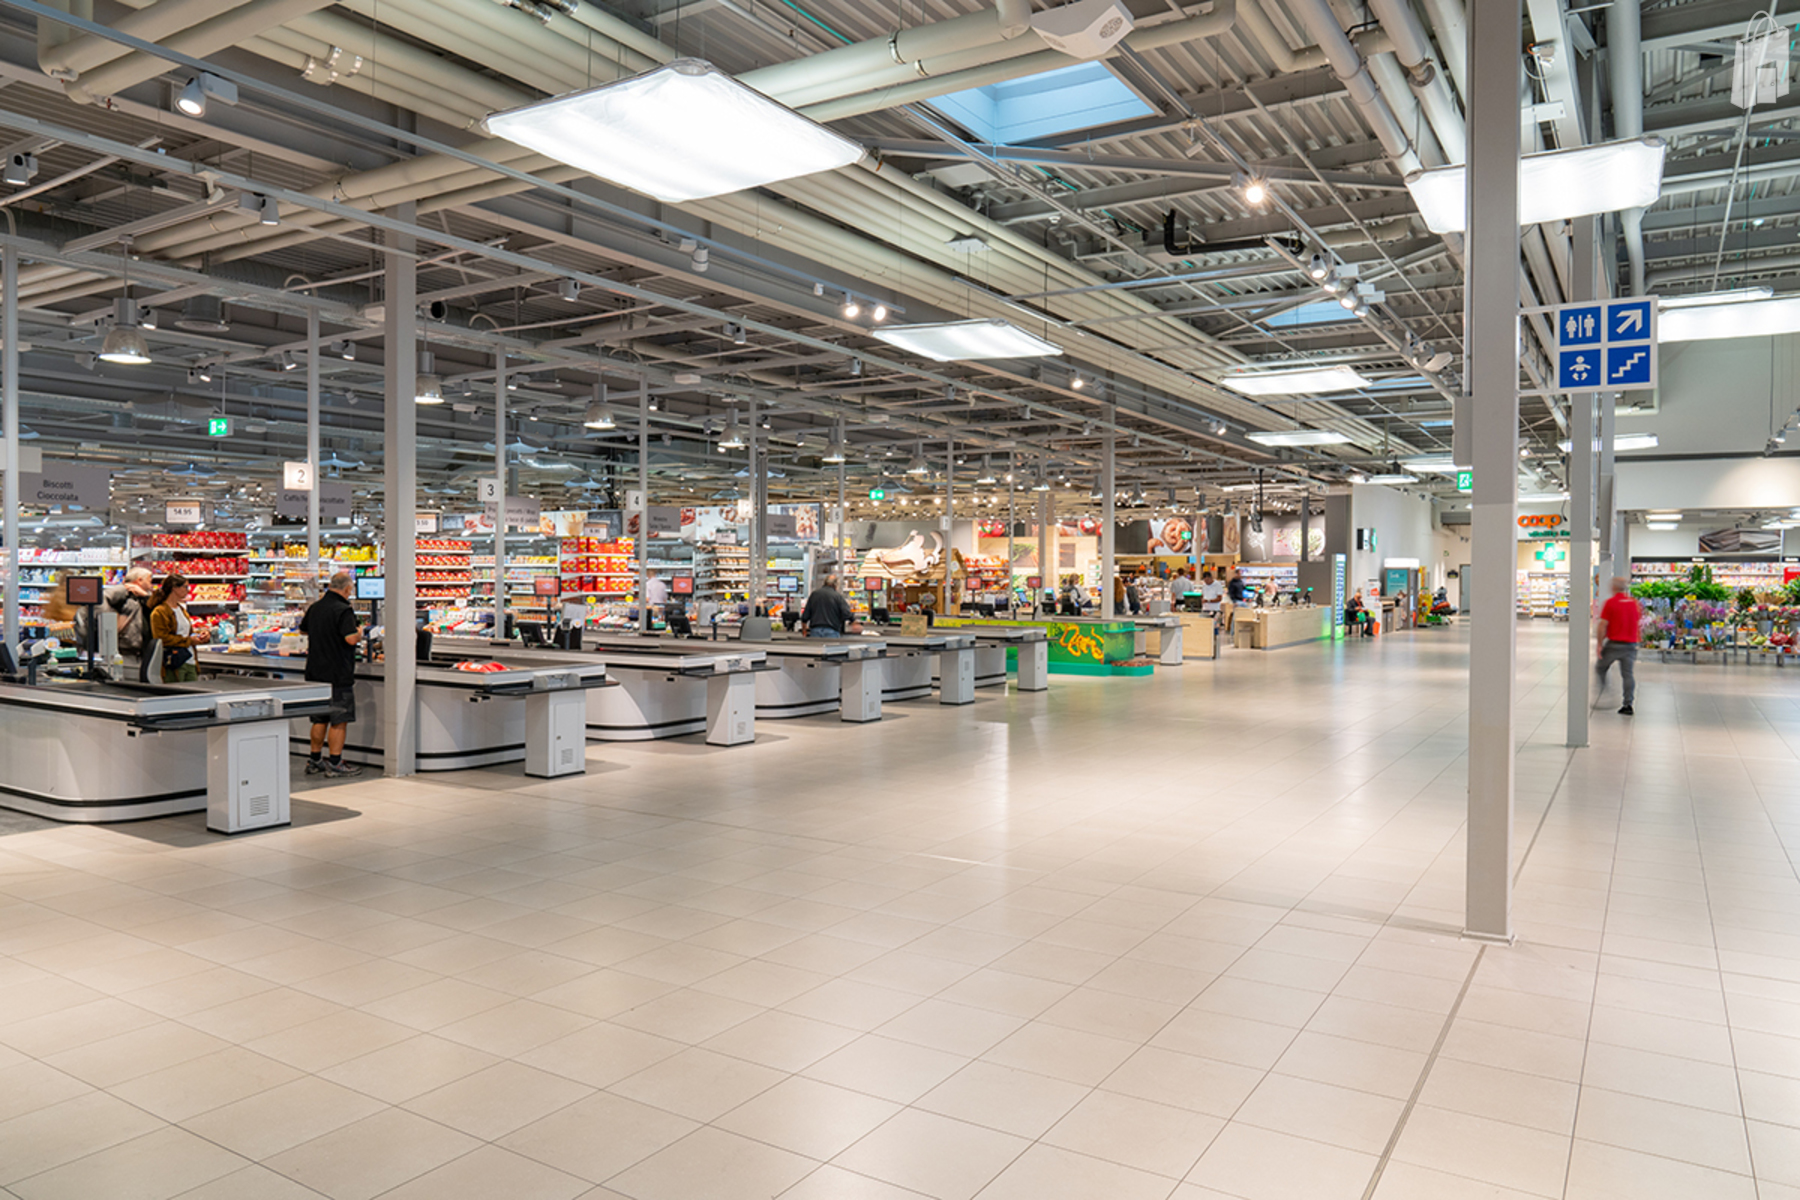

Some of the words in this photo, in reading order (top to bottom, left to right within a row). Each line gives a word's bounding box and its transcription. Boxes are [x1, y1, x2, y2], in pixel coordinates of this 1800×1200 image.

[298, 469, 305, 483] 2
[43, 479, 74, 489] Biscotti
[37, 491, 79, 501] Cioccolata
[487, 484, 494, 497] 3
[634, 496, 639, 506] 4
[1517, 514, 1562, 529] coop
